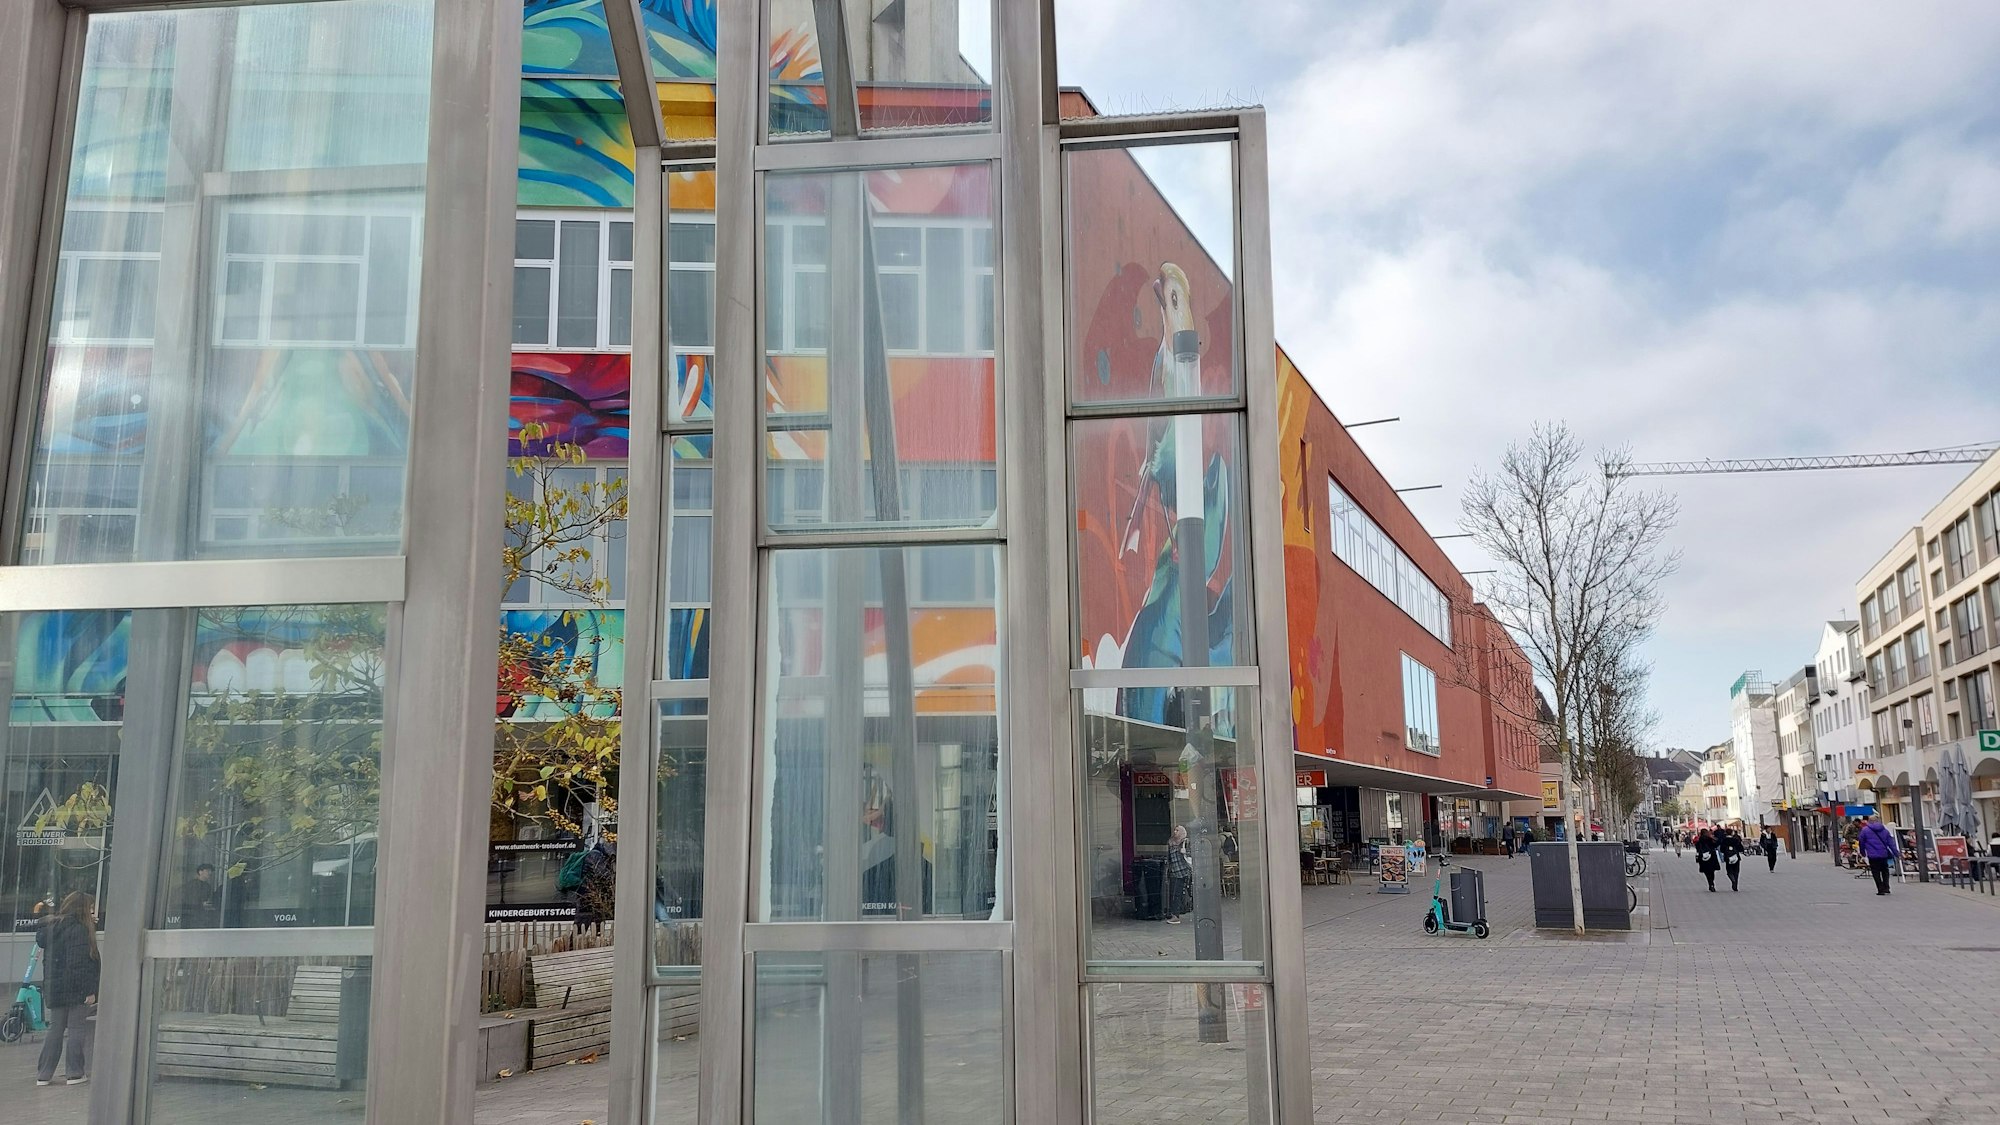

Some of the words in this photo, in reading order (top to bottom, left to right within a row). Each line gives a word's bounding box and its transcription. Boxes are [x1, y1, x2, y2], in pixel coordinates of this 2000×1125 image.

[1857, 761, 1875, 770] dm
[1296, 775, 1312, 786] ER
[494, 842, 577, 850] www.stuntwerk-troisdorf.de
[488, 908, 577, 918] KINDERGEBURTSTAGE
[274, 914, 297, 922] YOGA
